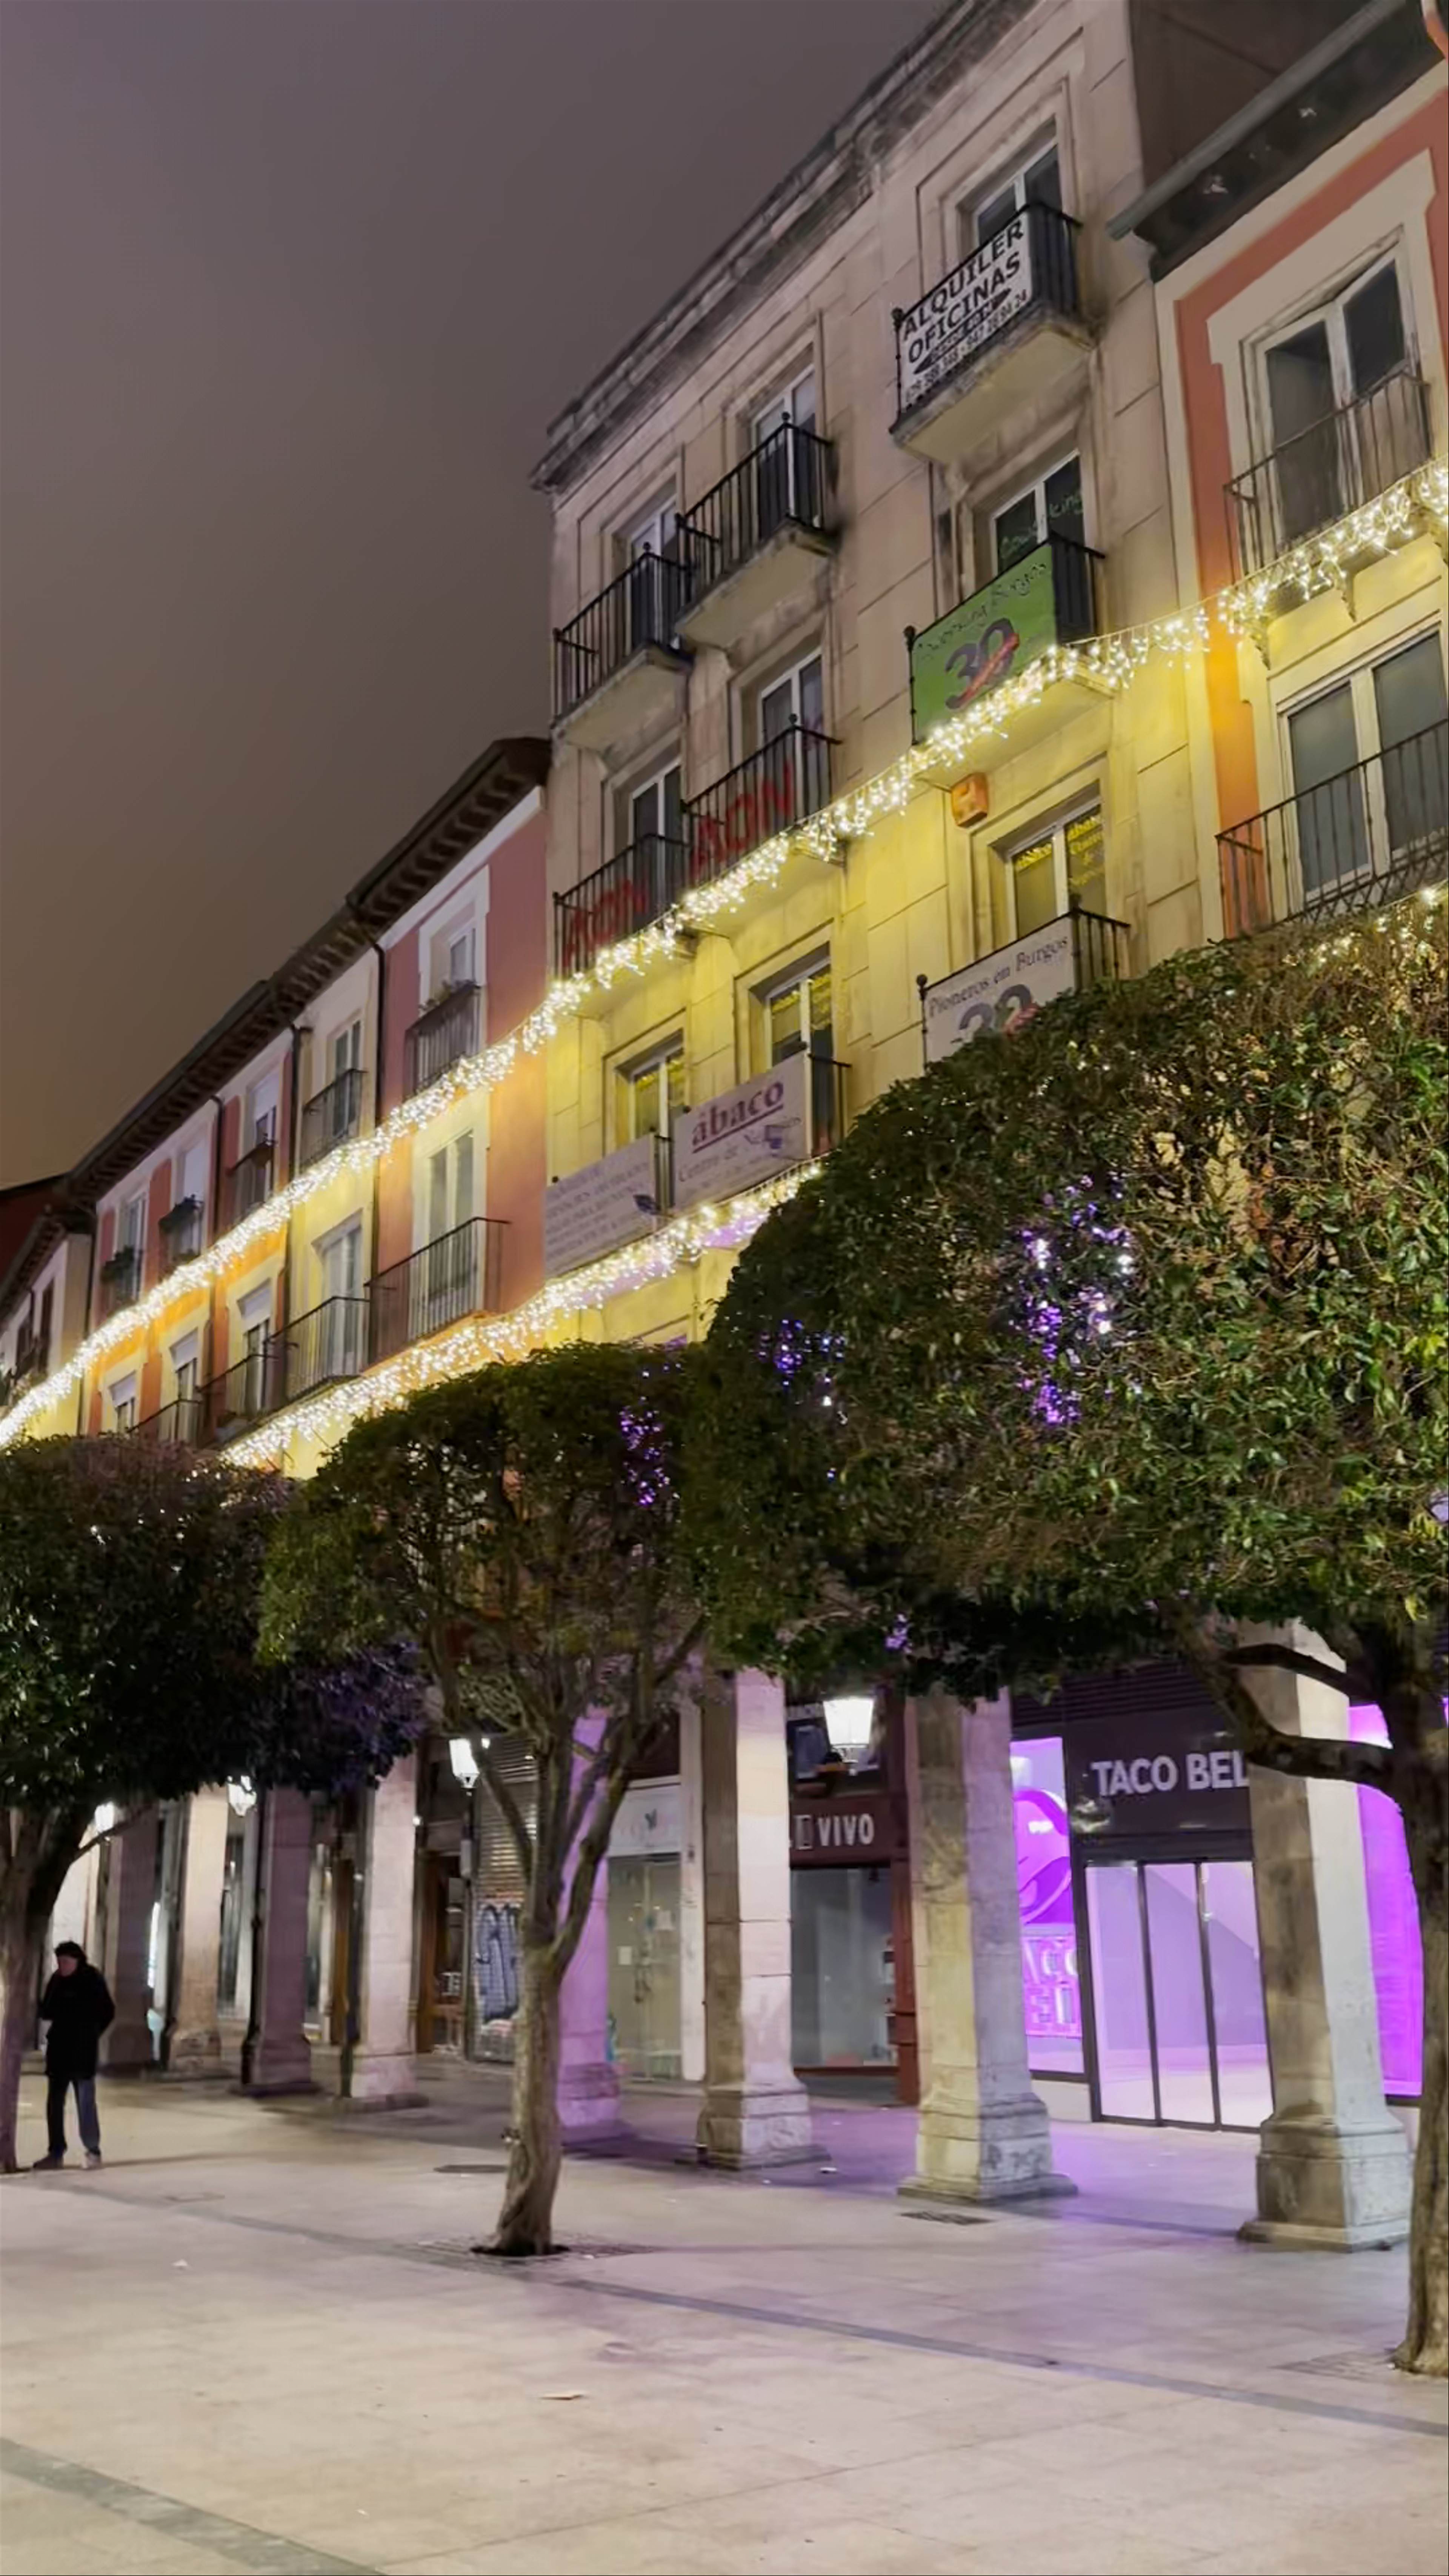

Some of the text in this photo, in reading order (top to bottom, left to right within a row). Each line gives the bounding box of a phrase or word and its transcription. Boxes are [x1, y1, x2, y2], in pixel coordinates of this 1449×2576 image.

[904, 221, 1024, 339] ALQUILER
[909, 252, 1020, 363] OFICINAS
[1017, 936, 1068, 971] Burgos
[1090, 1749, 1250, 1796] TACO BEL
[817, 1813, 875, 1846] VIVO
